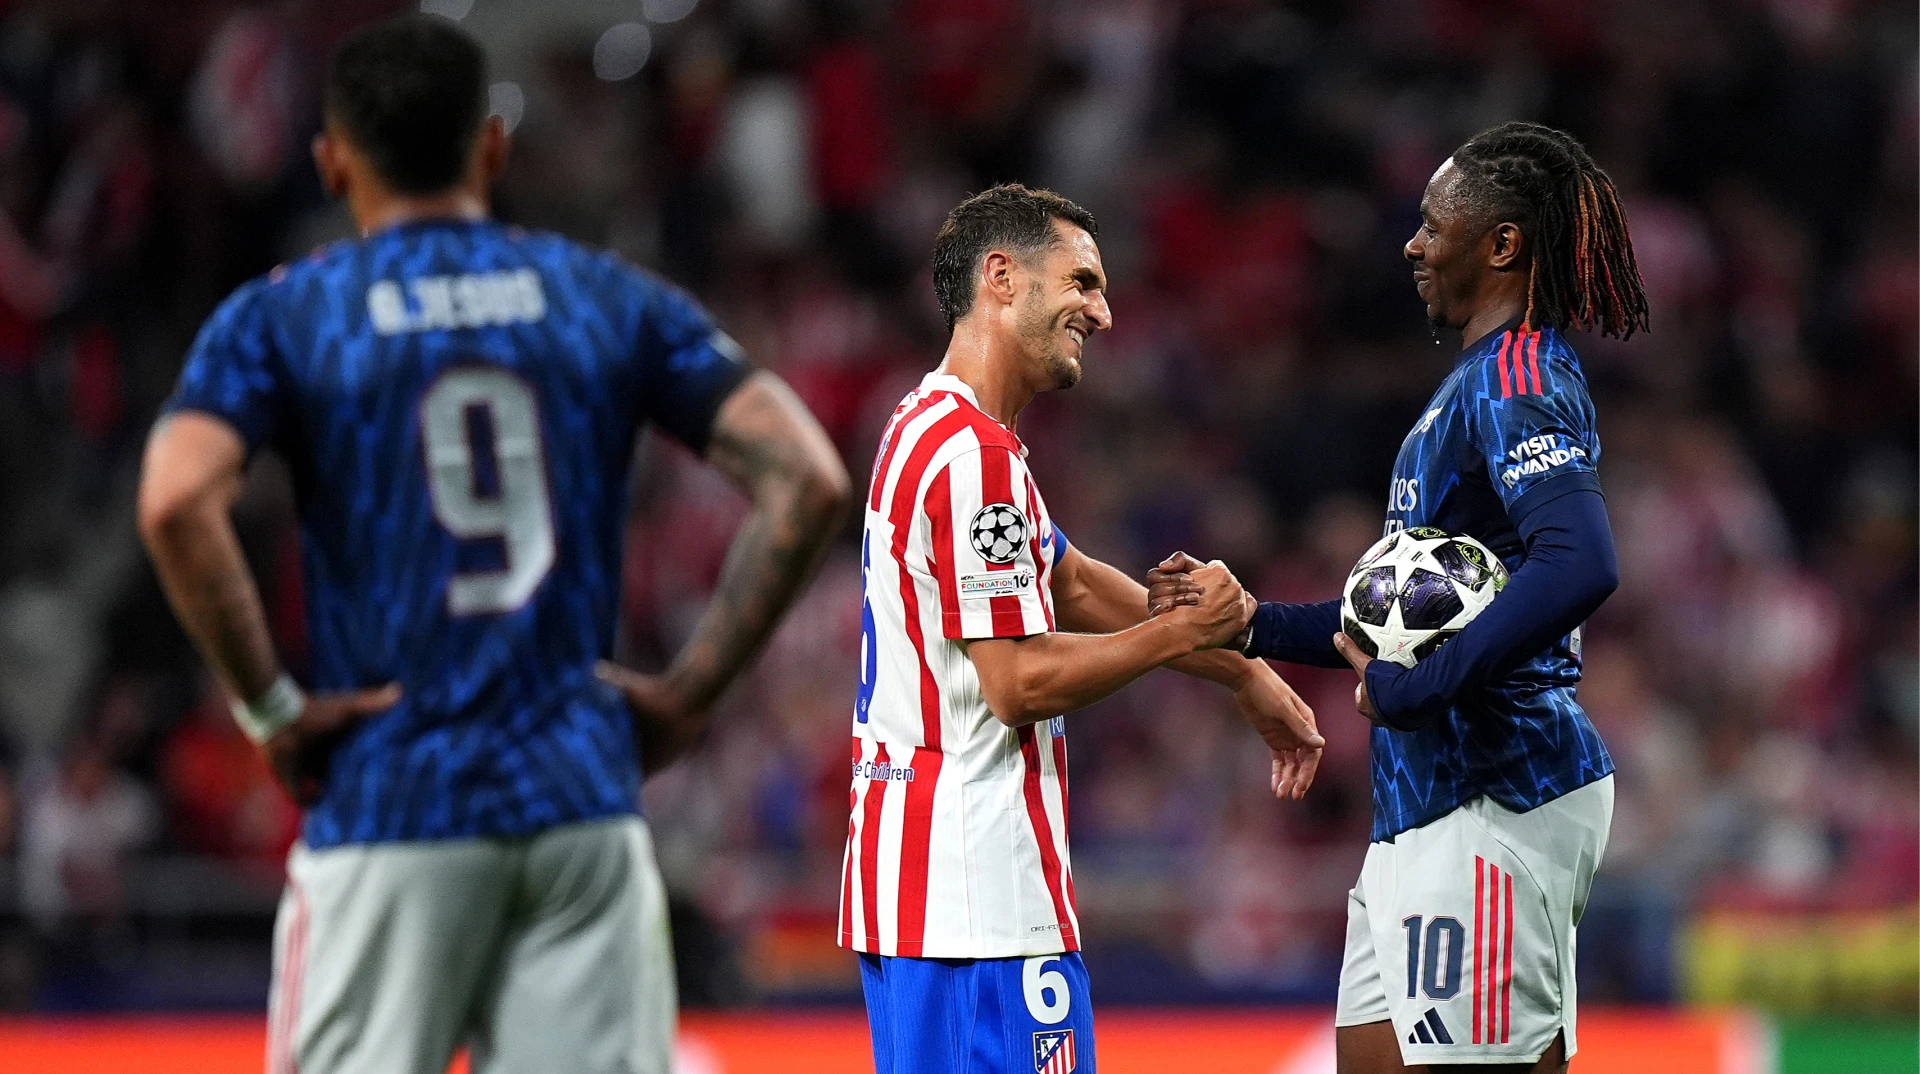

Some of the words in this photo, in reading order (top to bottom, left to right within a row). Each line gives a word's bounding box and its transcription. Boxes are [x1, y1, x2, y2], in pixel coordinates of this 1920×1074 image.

[1501, 446, 1586, 489] RWANDA
[1509, 434, 1556, 462] VISIT
[422, 366, 556, 616] 9
[962, 580, 1013, 590] FOUNDATION
[864, 761, 914, 781] Children
[1402, 914, 1466, 1001] 10
[1022, 956, 1071, 1024] 6
